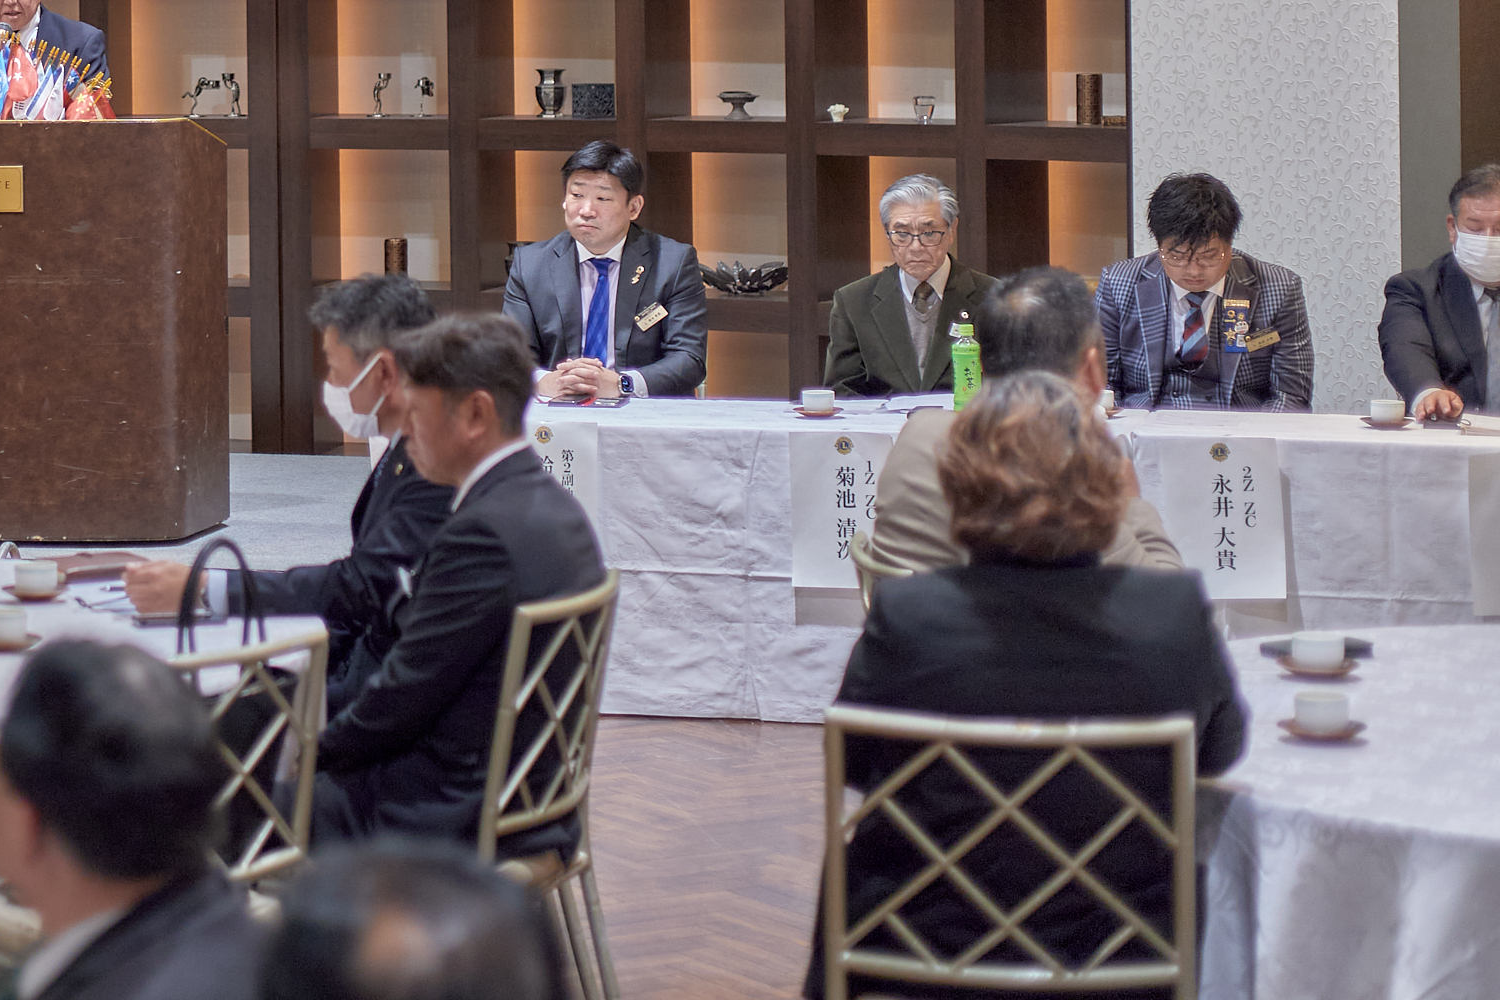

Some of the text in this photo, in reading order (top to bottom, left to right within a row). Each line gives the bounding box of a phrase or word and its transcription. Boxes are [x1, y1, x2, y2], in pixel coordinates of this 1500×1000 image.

[834, 466, 857, 509] 菊池
[864, 460, 877, 520] 1Z ZC
[1242, 465, 1257, 528] 2Z ZC
[1211, 473, 1238, 571] 永井 大貴
